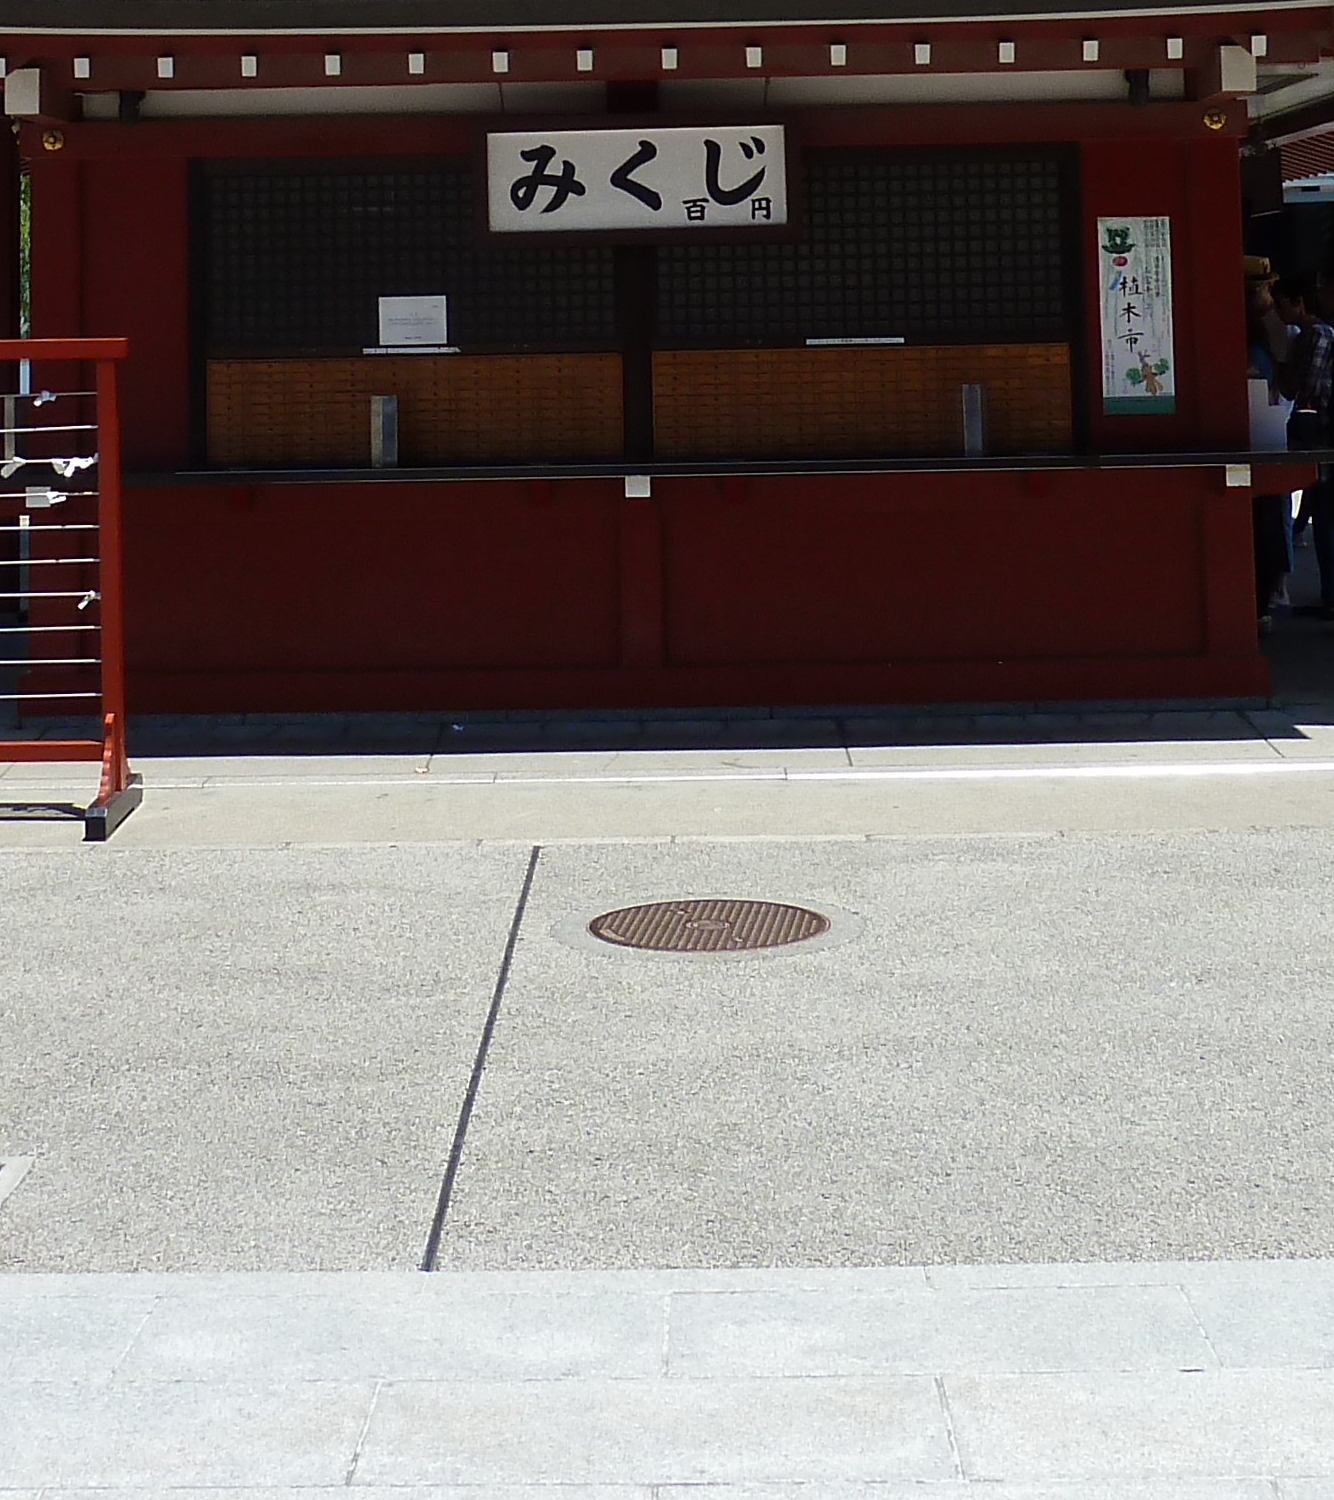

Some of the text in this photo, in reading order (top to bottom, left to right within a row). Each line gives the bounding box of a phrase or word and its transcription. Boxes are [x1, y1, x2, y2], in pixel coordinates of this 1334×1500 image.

[509, 136, 767, 214] みくじ
[1118, 275, 1145, 354] 植木市
